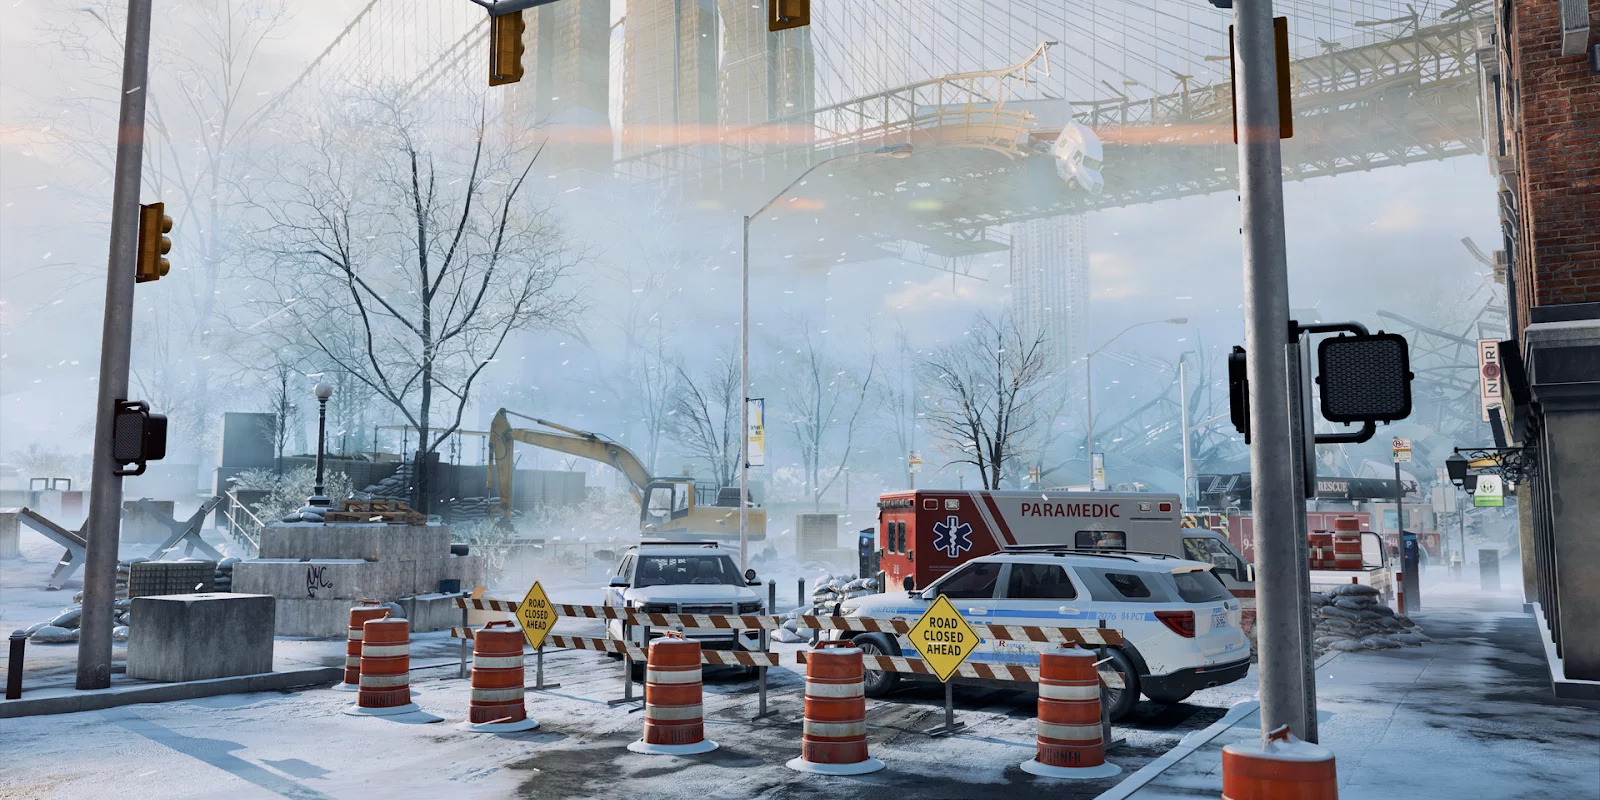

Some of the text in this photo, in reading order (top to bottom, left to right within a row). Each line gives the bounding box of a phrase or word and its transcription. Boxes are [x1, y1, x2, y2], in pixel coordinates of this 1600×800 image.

[1485, 346, 1498, 393] NIGIRI
[1317, 481, 1348, 492] RESCUE
[1021, 502, 1120, 518] PARAMEDIC
[528, 599, 546, 609] ROAD
[524, 609, 549, 620] CLOSED
[1097, 611, 1145, 621] 2076 84 PCT
[526, 620, 547, 630] AHEAD
[929, 617, 958, 629] ROAD
[923, 630, 964, 643] CLOSED
[926, 644, 962, 656] AHEAD
